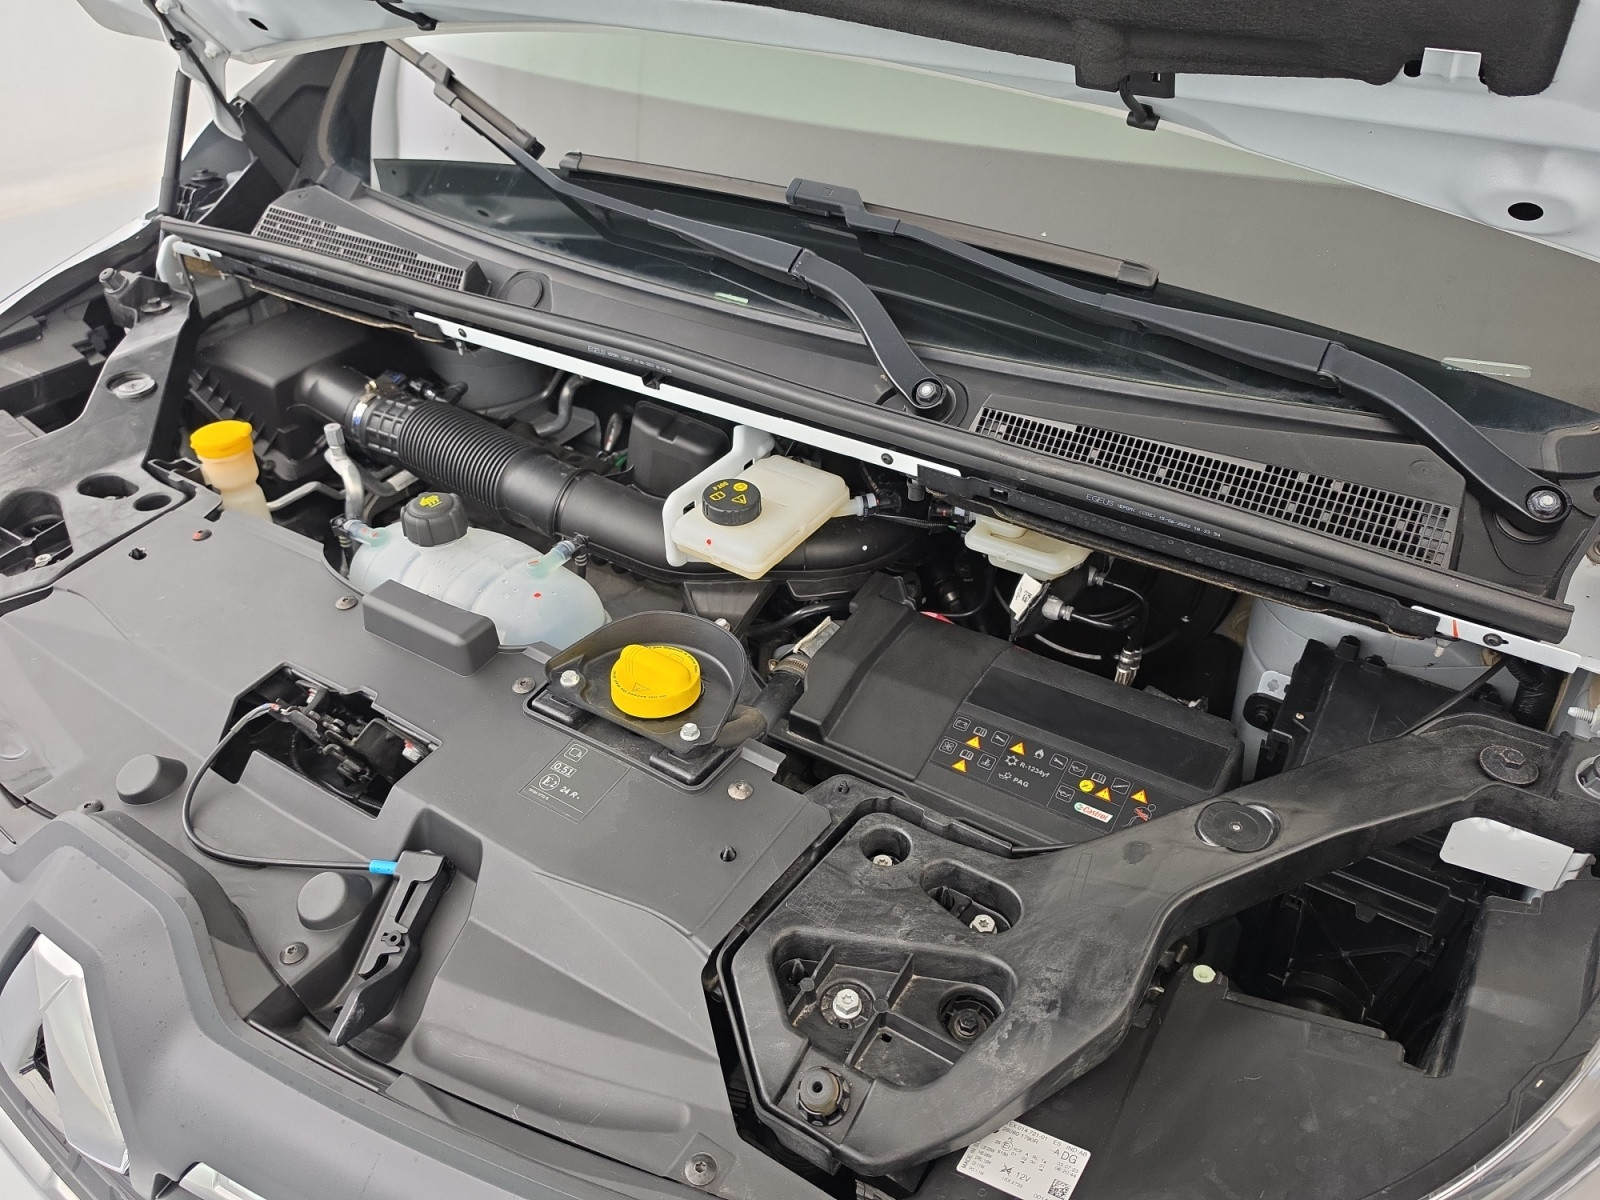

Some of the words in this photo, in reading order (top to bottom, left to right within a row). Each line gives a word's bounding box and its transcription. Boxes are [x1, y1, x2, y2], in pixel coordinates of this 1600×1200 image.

[1085, 493, 1114, 507] EGEUS
[553, 762, 574, 777] 0.51
[1019, 762, 1050, 778] R-1234yf
[1012, 777, 1030, 788] PAG
[1083, 806, 1109, 821] Castrol
[1060, 1151, 1078, 1164] DG
[1016, 1172, 1032, 1182] 12V
